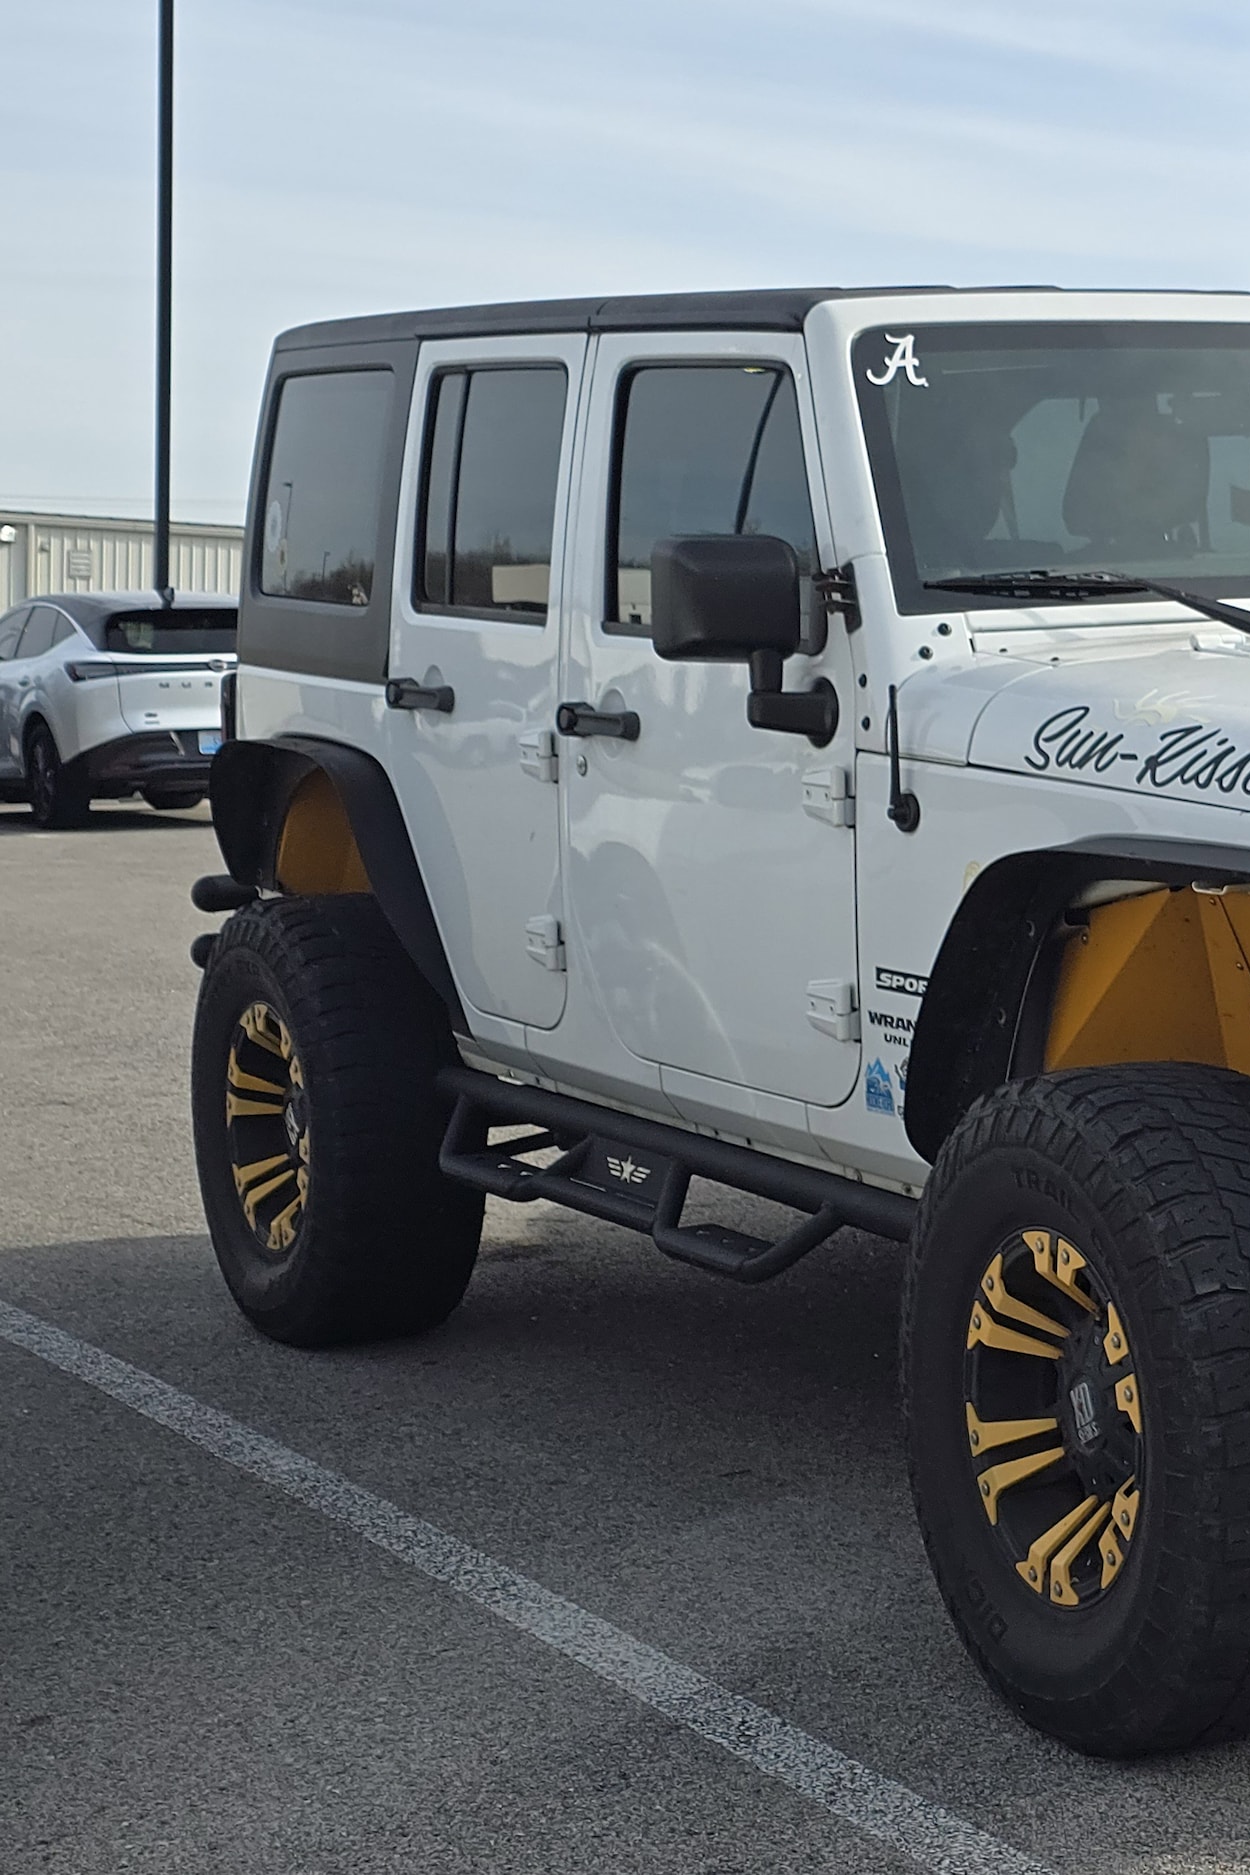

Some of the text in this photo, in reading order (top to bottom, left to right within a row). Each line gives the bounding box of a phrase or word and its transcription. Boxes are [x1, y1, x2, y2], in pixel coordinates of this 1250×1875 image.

[866, 333, 929, 387] A
[879, 972, 928, 994] SPOR
[868, 1010, 915, 1033] WRAN
[884, 1032, 909, 1047] UNL
